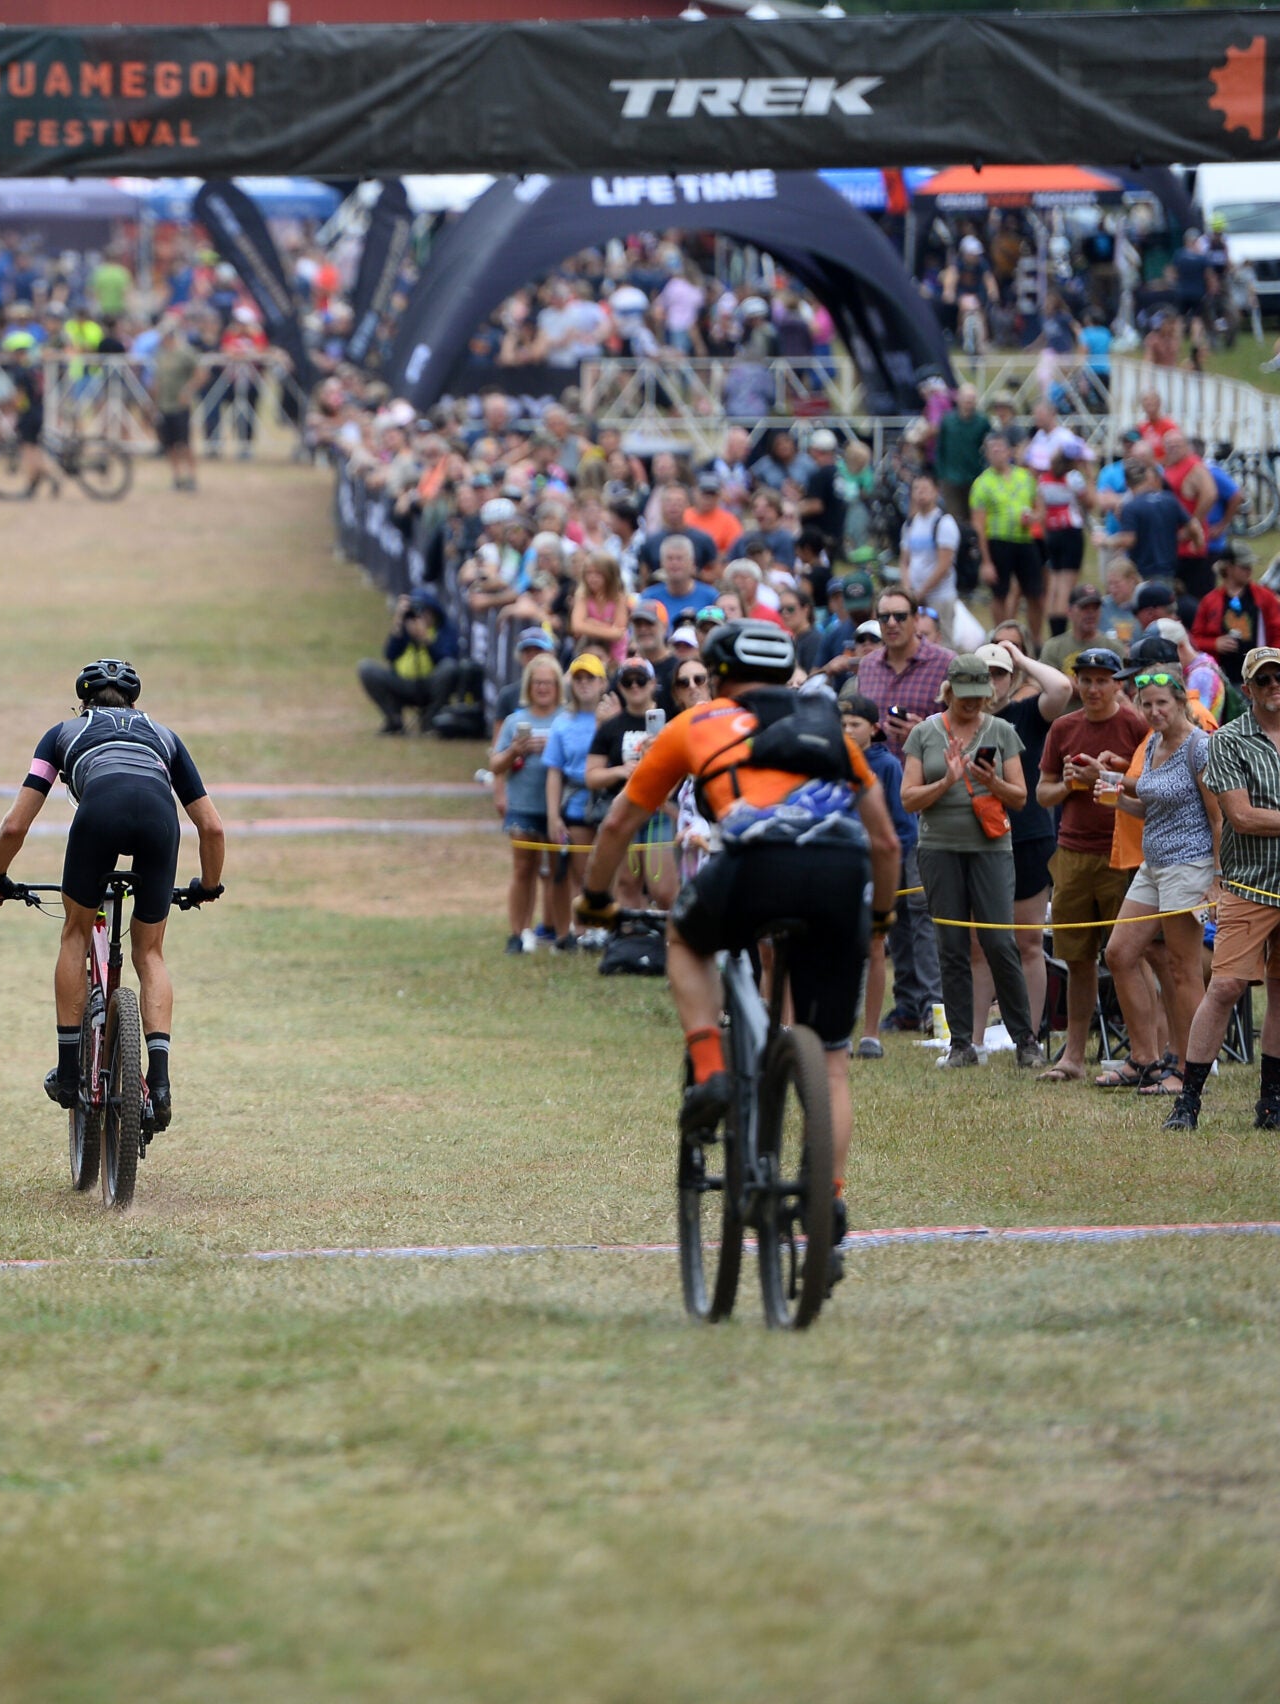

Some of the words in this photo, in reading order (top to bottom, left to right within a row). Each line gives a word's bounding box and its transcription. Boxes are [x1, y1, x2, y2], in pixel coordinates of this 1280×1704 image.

[608, 75, 885, 118] TREK
[13, 119, 199, 147] FESTIVAL
[591, 174, 676, 206] LIFE
[677, 168, 777, 204] TIME
